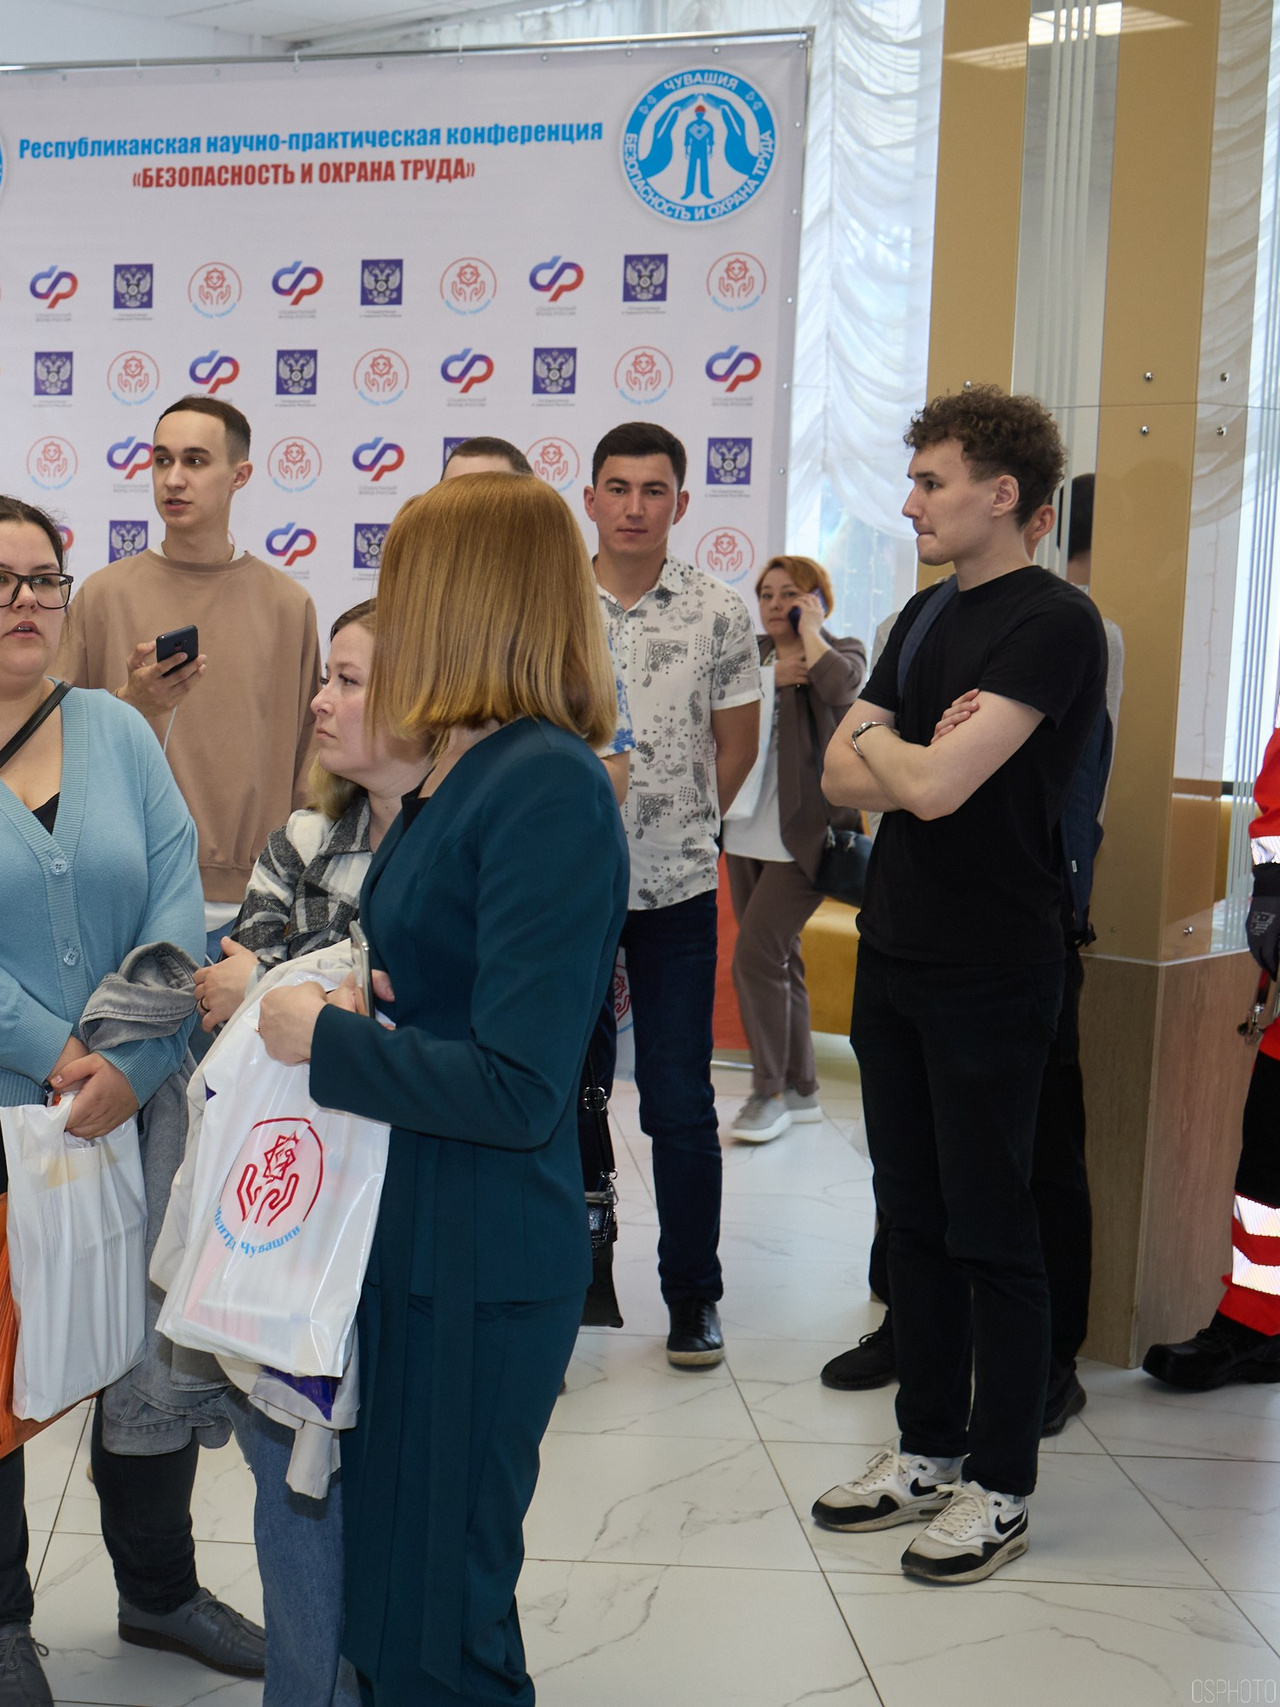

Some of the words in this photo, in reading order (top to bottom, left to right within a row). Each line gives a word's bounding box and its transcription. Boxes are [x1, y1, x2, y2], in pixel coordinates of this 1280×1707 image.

[663, 71, 740, 91] ЧУВАШИЯ
[19, 134, 202, 160] Республиканская
[206, 127, 442, 155] научно-практическая
[446, 122, 604, 148] конференция
[132, 163, 296, 189] «БЕЗОПАСНОСТЬ
[300, 162, 314, 184] И
[318, 160, 396, 184] ОХРАНА
[400, 157, 476, 182] ТРУДА»
[624, 132, 692, 220] БЕЗОПАСНОСТЬ
[694, 207, 706, 221] И
[707, 178, 761, 218] ОХРАНА
[751, 129, 775, 178] ТРУДА
